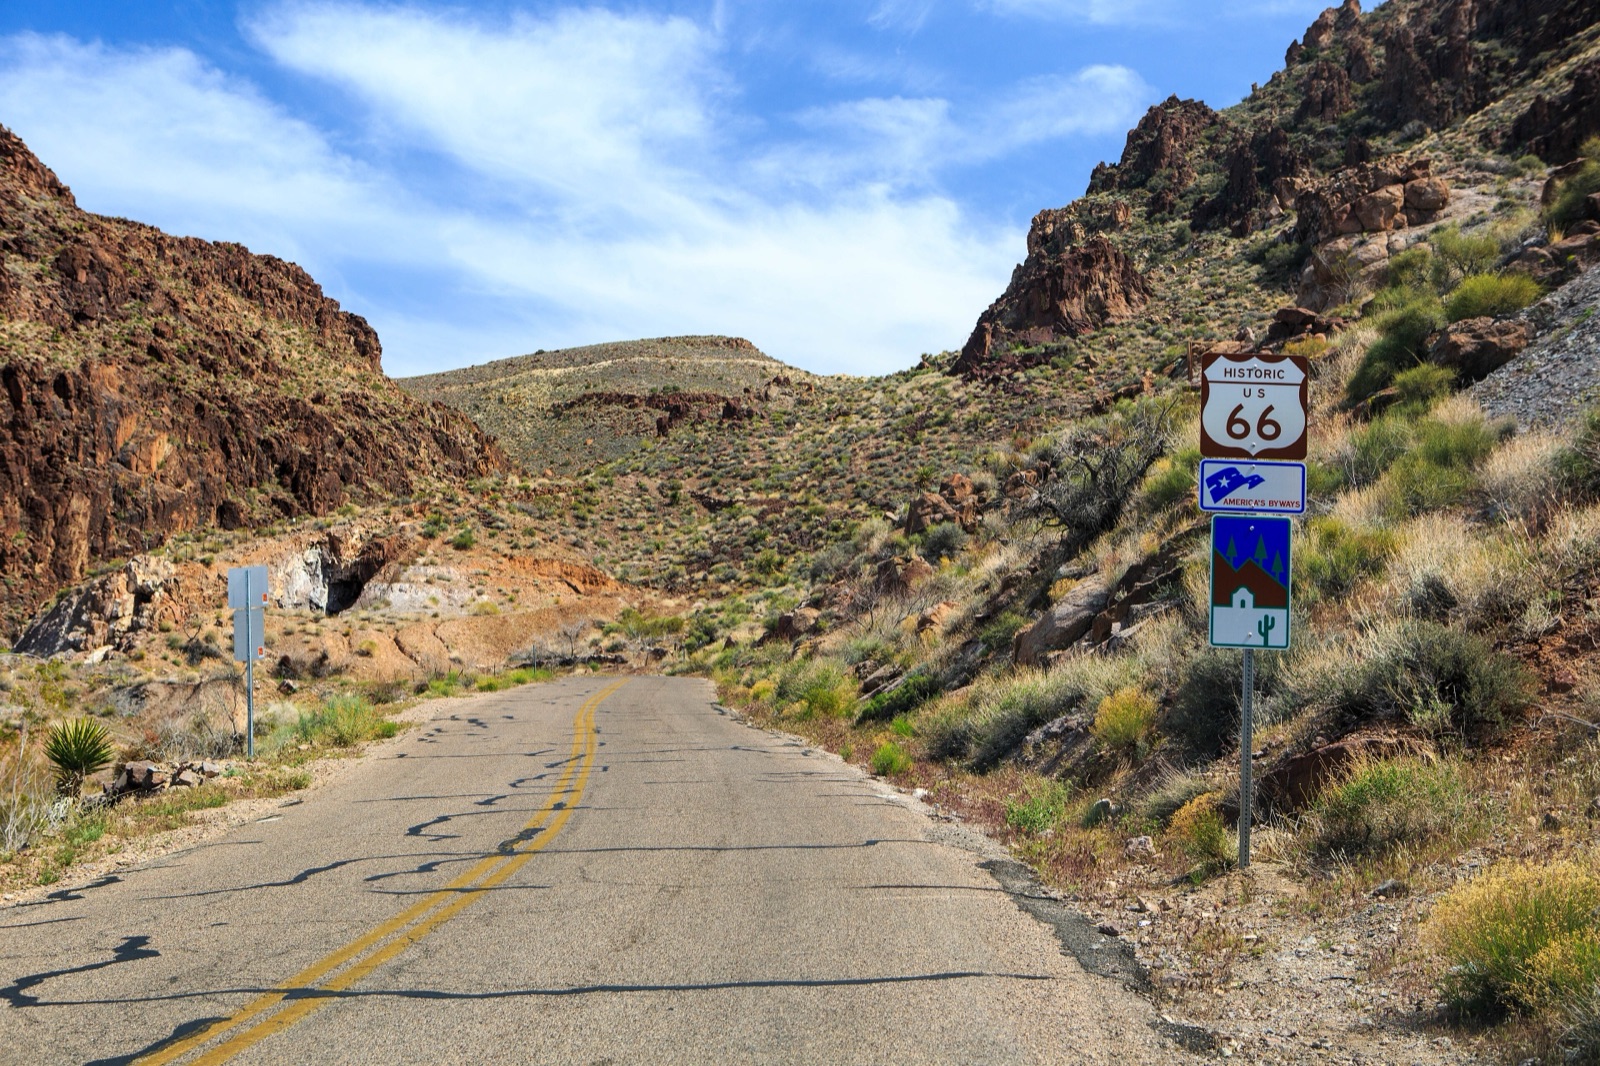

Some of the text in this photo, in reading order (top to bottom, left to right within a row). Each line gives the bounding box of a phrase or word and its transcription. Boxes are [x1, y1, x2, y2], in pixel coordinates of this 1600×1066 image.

[1224, 367, 1285, 380] HISTORIC
[1226, 403, 1282, 441] 66
[1223, 498, 1301, 508] AMERICA'S BYWAYS
